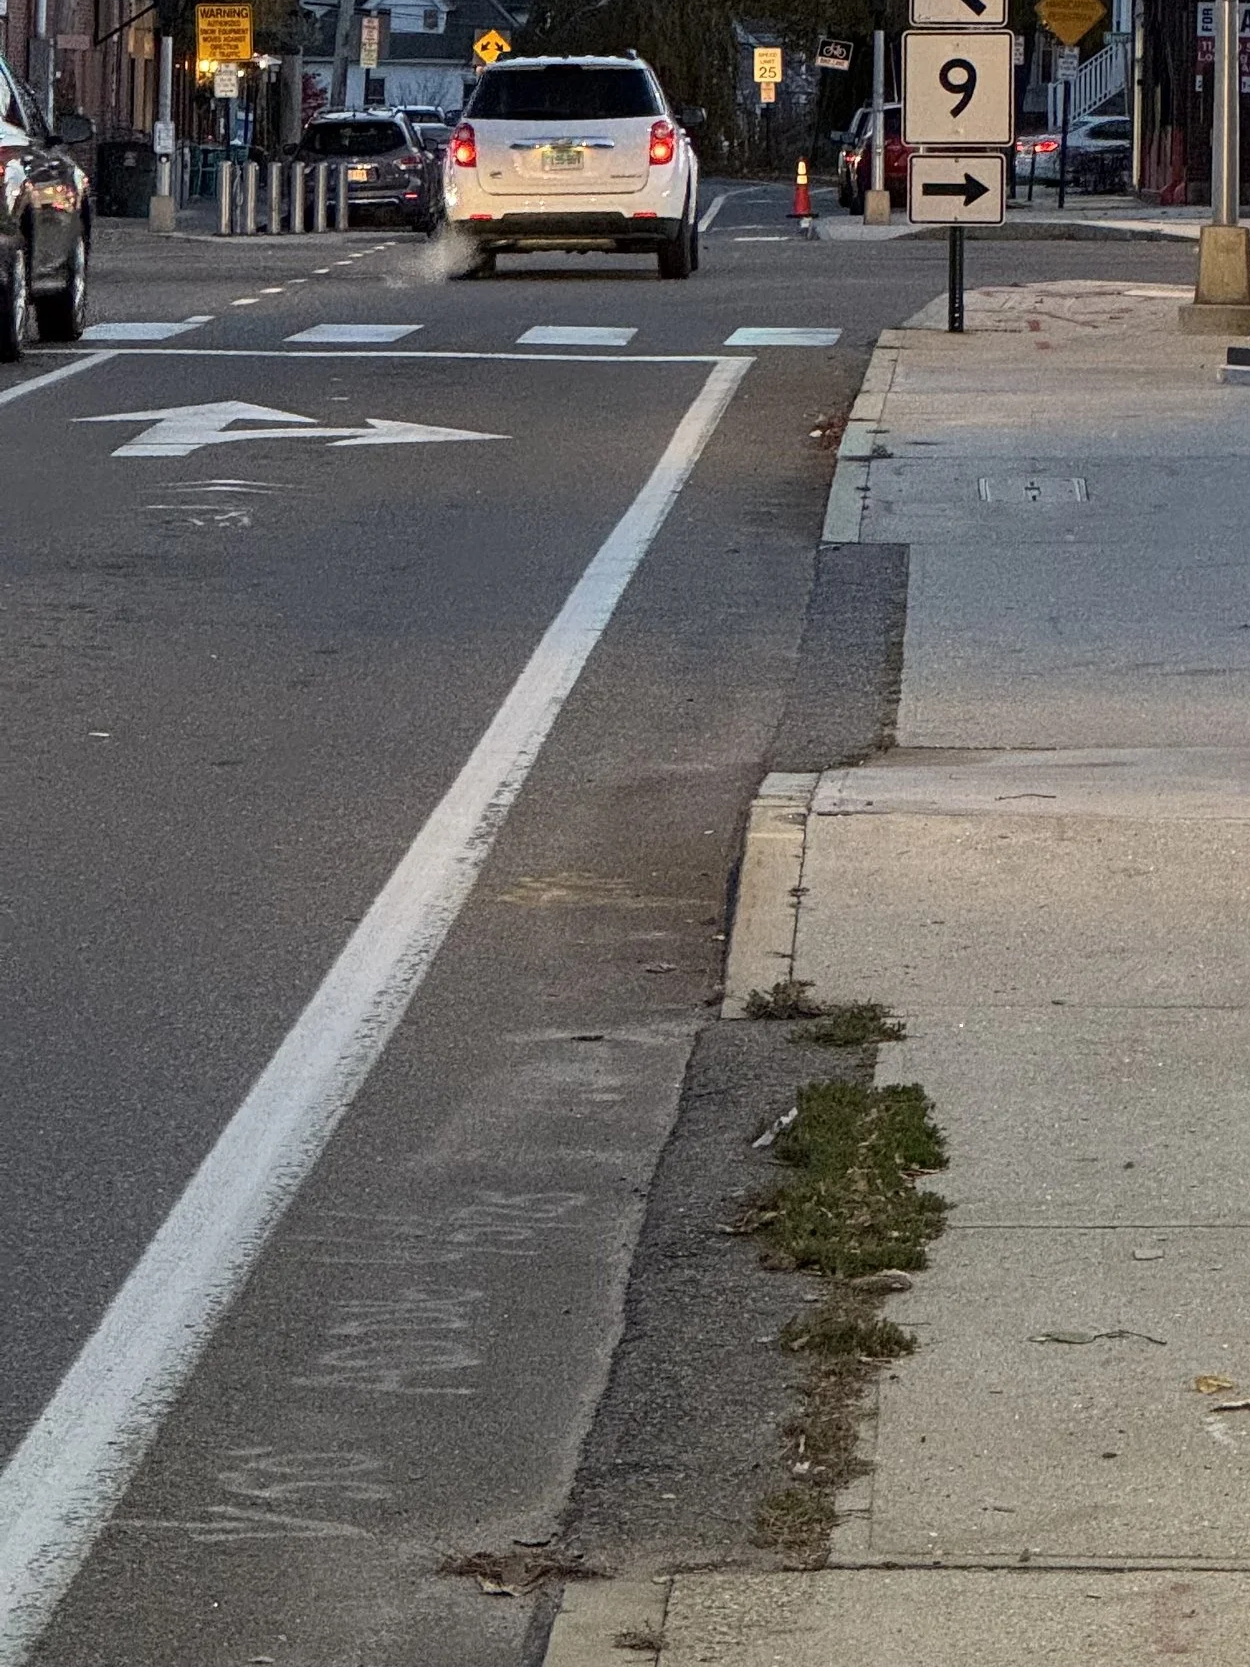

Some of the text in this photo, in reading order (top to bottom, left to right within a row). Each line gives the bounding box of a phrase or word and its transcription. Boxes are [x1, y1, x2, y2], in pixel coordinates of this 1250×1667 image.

[200, 8, 249, 19] WARNING
[1202, 8, 1213, 32] FOR
[758, 66, 777, 79] 25
[939, 58, 977, 119] 9
